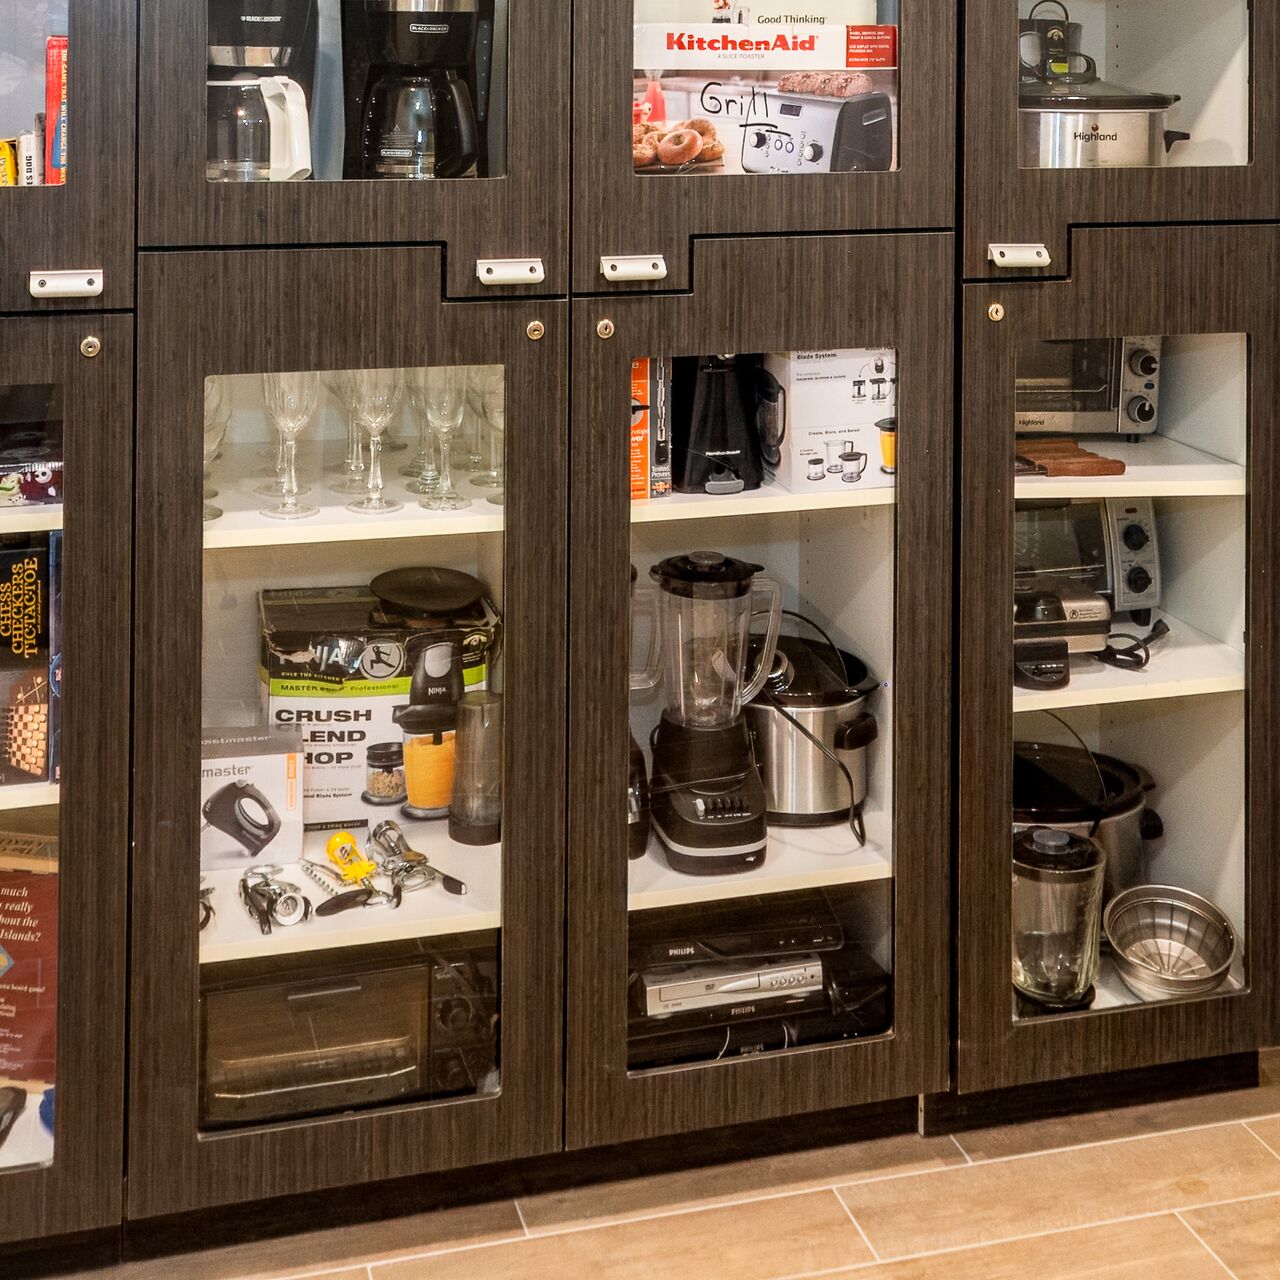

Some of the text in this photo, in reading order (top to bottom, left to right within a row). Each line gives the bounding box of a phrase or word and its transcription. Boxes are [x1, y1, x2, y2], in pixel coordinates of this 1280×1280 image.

[757, 14, 825, 25] Good Thinking
[666, 31, 816, 52] KitchenAid
[1073, 131, 1118, 143] Highland
[0, 581, 12, 638] CHESS
[11, 562, 24, 655] CHECKERS
[274, 708, 372, 722] CRUSH
[0, 886, 29, 898] much
[4, 901, 33, 915] really
[22, 916, 39, 928] the
[0, 928, 42, 942] Islands?
[668, 947, 695, 956] PHILIPS
[731, 1005, 756, 1016] PHILIPS
